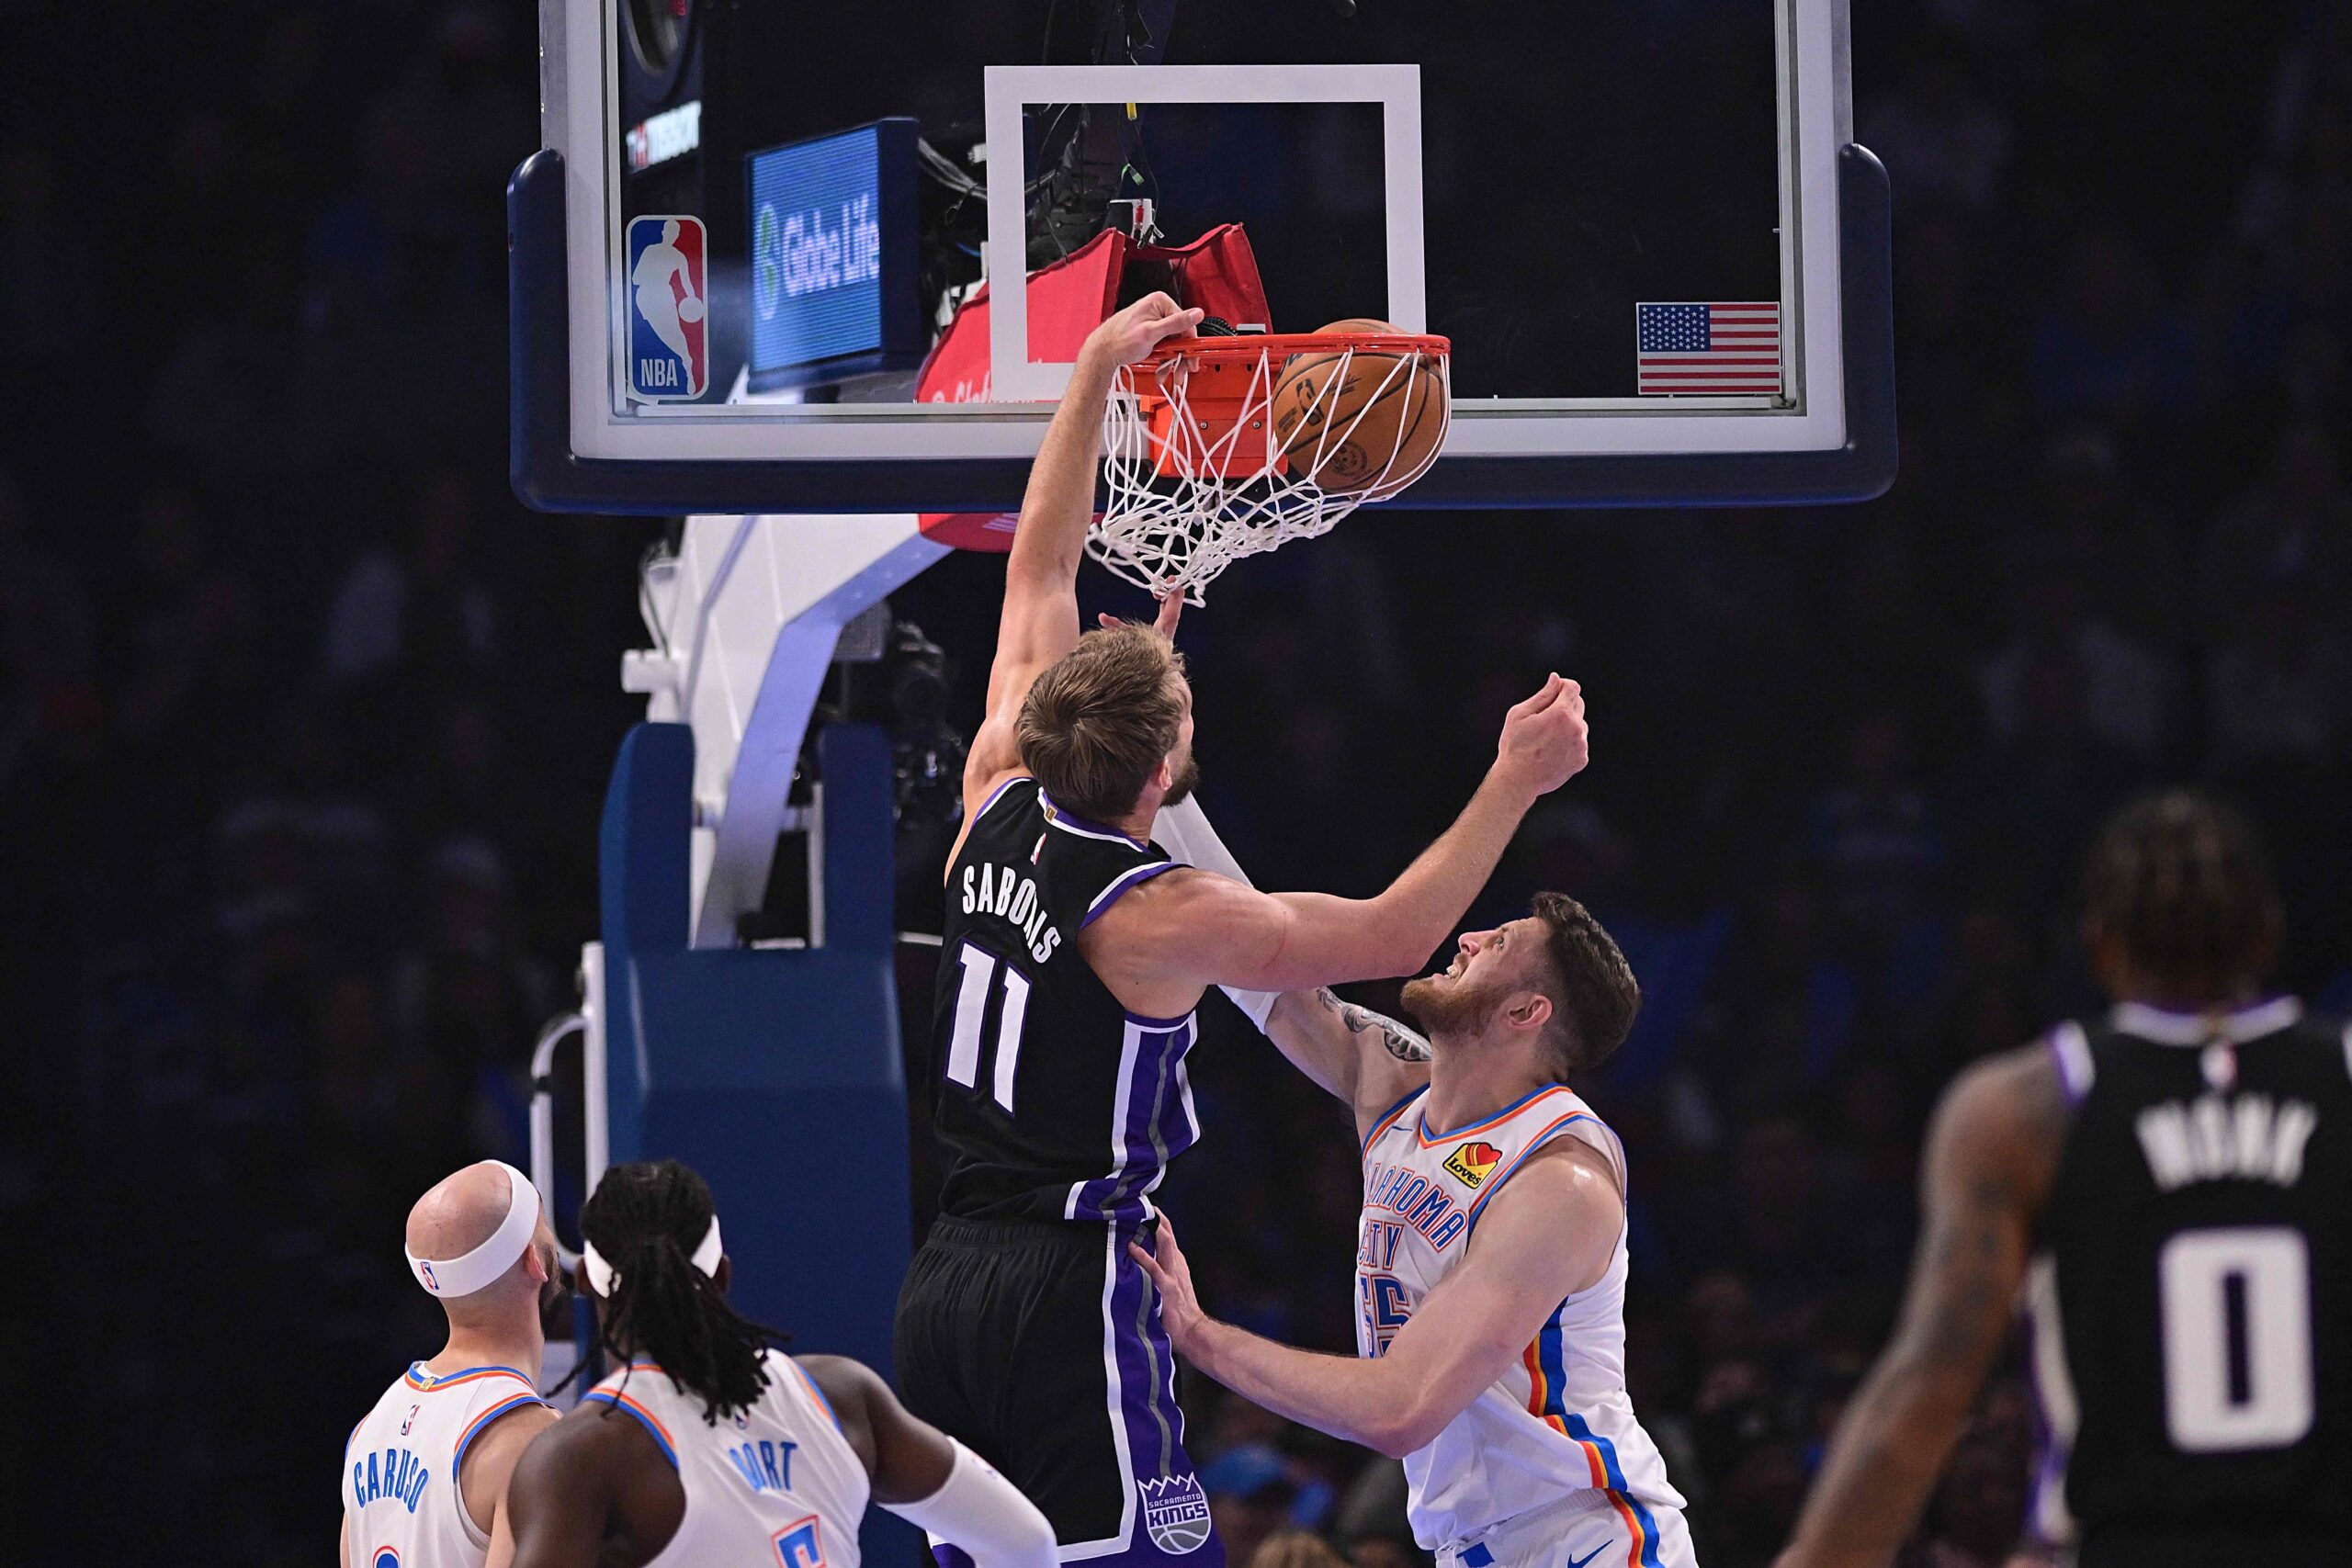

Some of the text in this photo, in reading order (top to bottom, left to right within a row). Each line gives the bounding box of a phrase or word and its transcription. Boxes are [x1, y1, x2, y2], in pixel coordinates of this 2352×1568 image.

[783, 194, 879, 297] Globe Life
[640, 358, 678, 387] NBA
[945, 939, 1033, 1116] 11
[2160, 1226, 2314, 1453] 0
[353, 1448, 429, 1514] CARUSO
[1148, 1493, 1202, 1508] SACRAMENTO
[1148, 1503, 1208, 1527] KINGS
